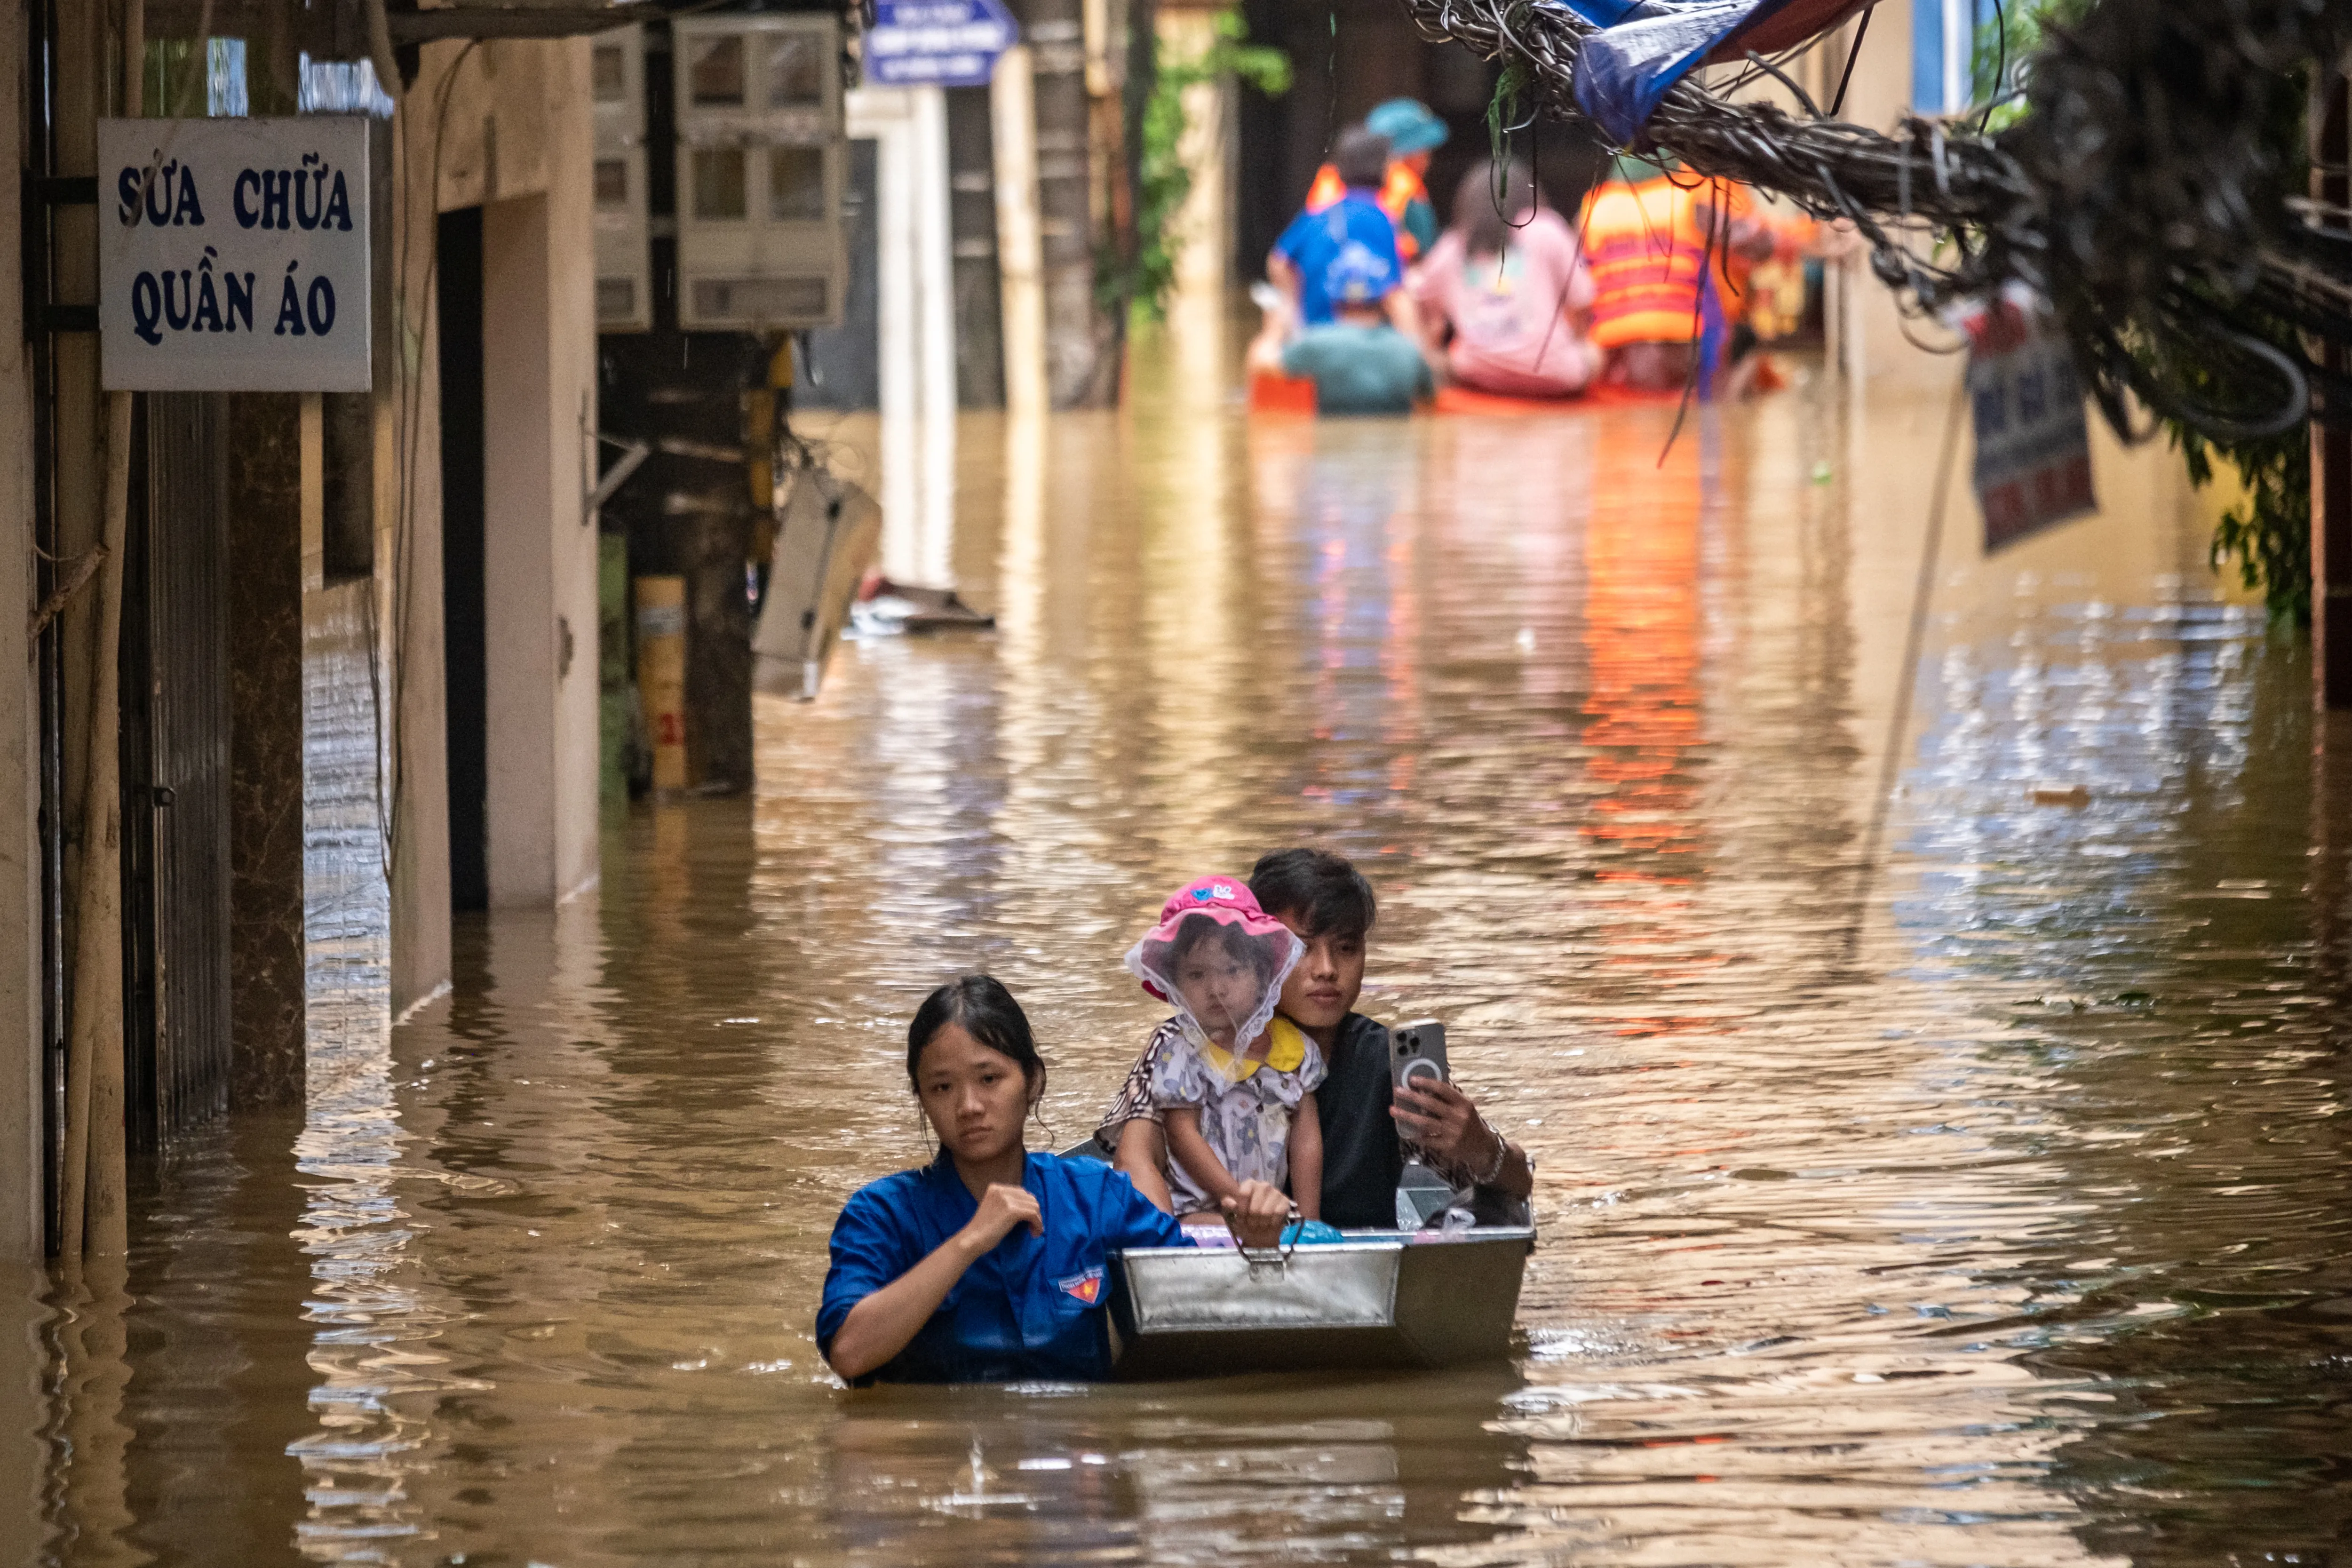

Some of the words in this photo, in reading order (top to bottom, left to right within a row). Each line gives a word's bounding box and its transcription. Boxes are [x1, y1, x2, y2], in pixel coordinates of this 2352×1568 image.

[233, 151, 353, 231] CHỮA
[131, 245, 255, 346] QUẦN
[274, 259, 336, 336] ÁO
